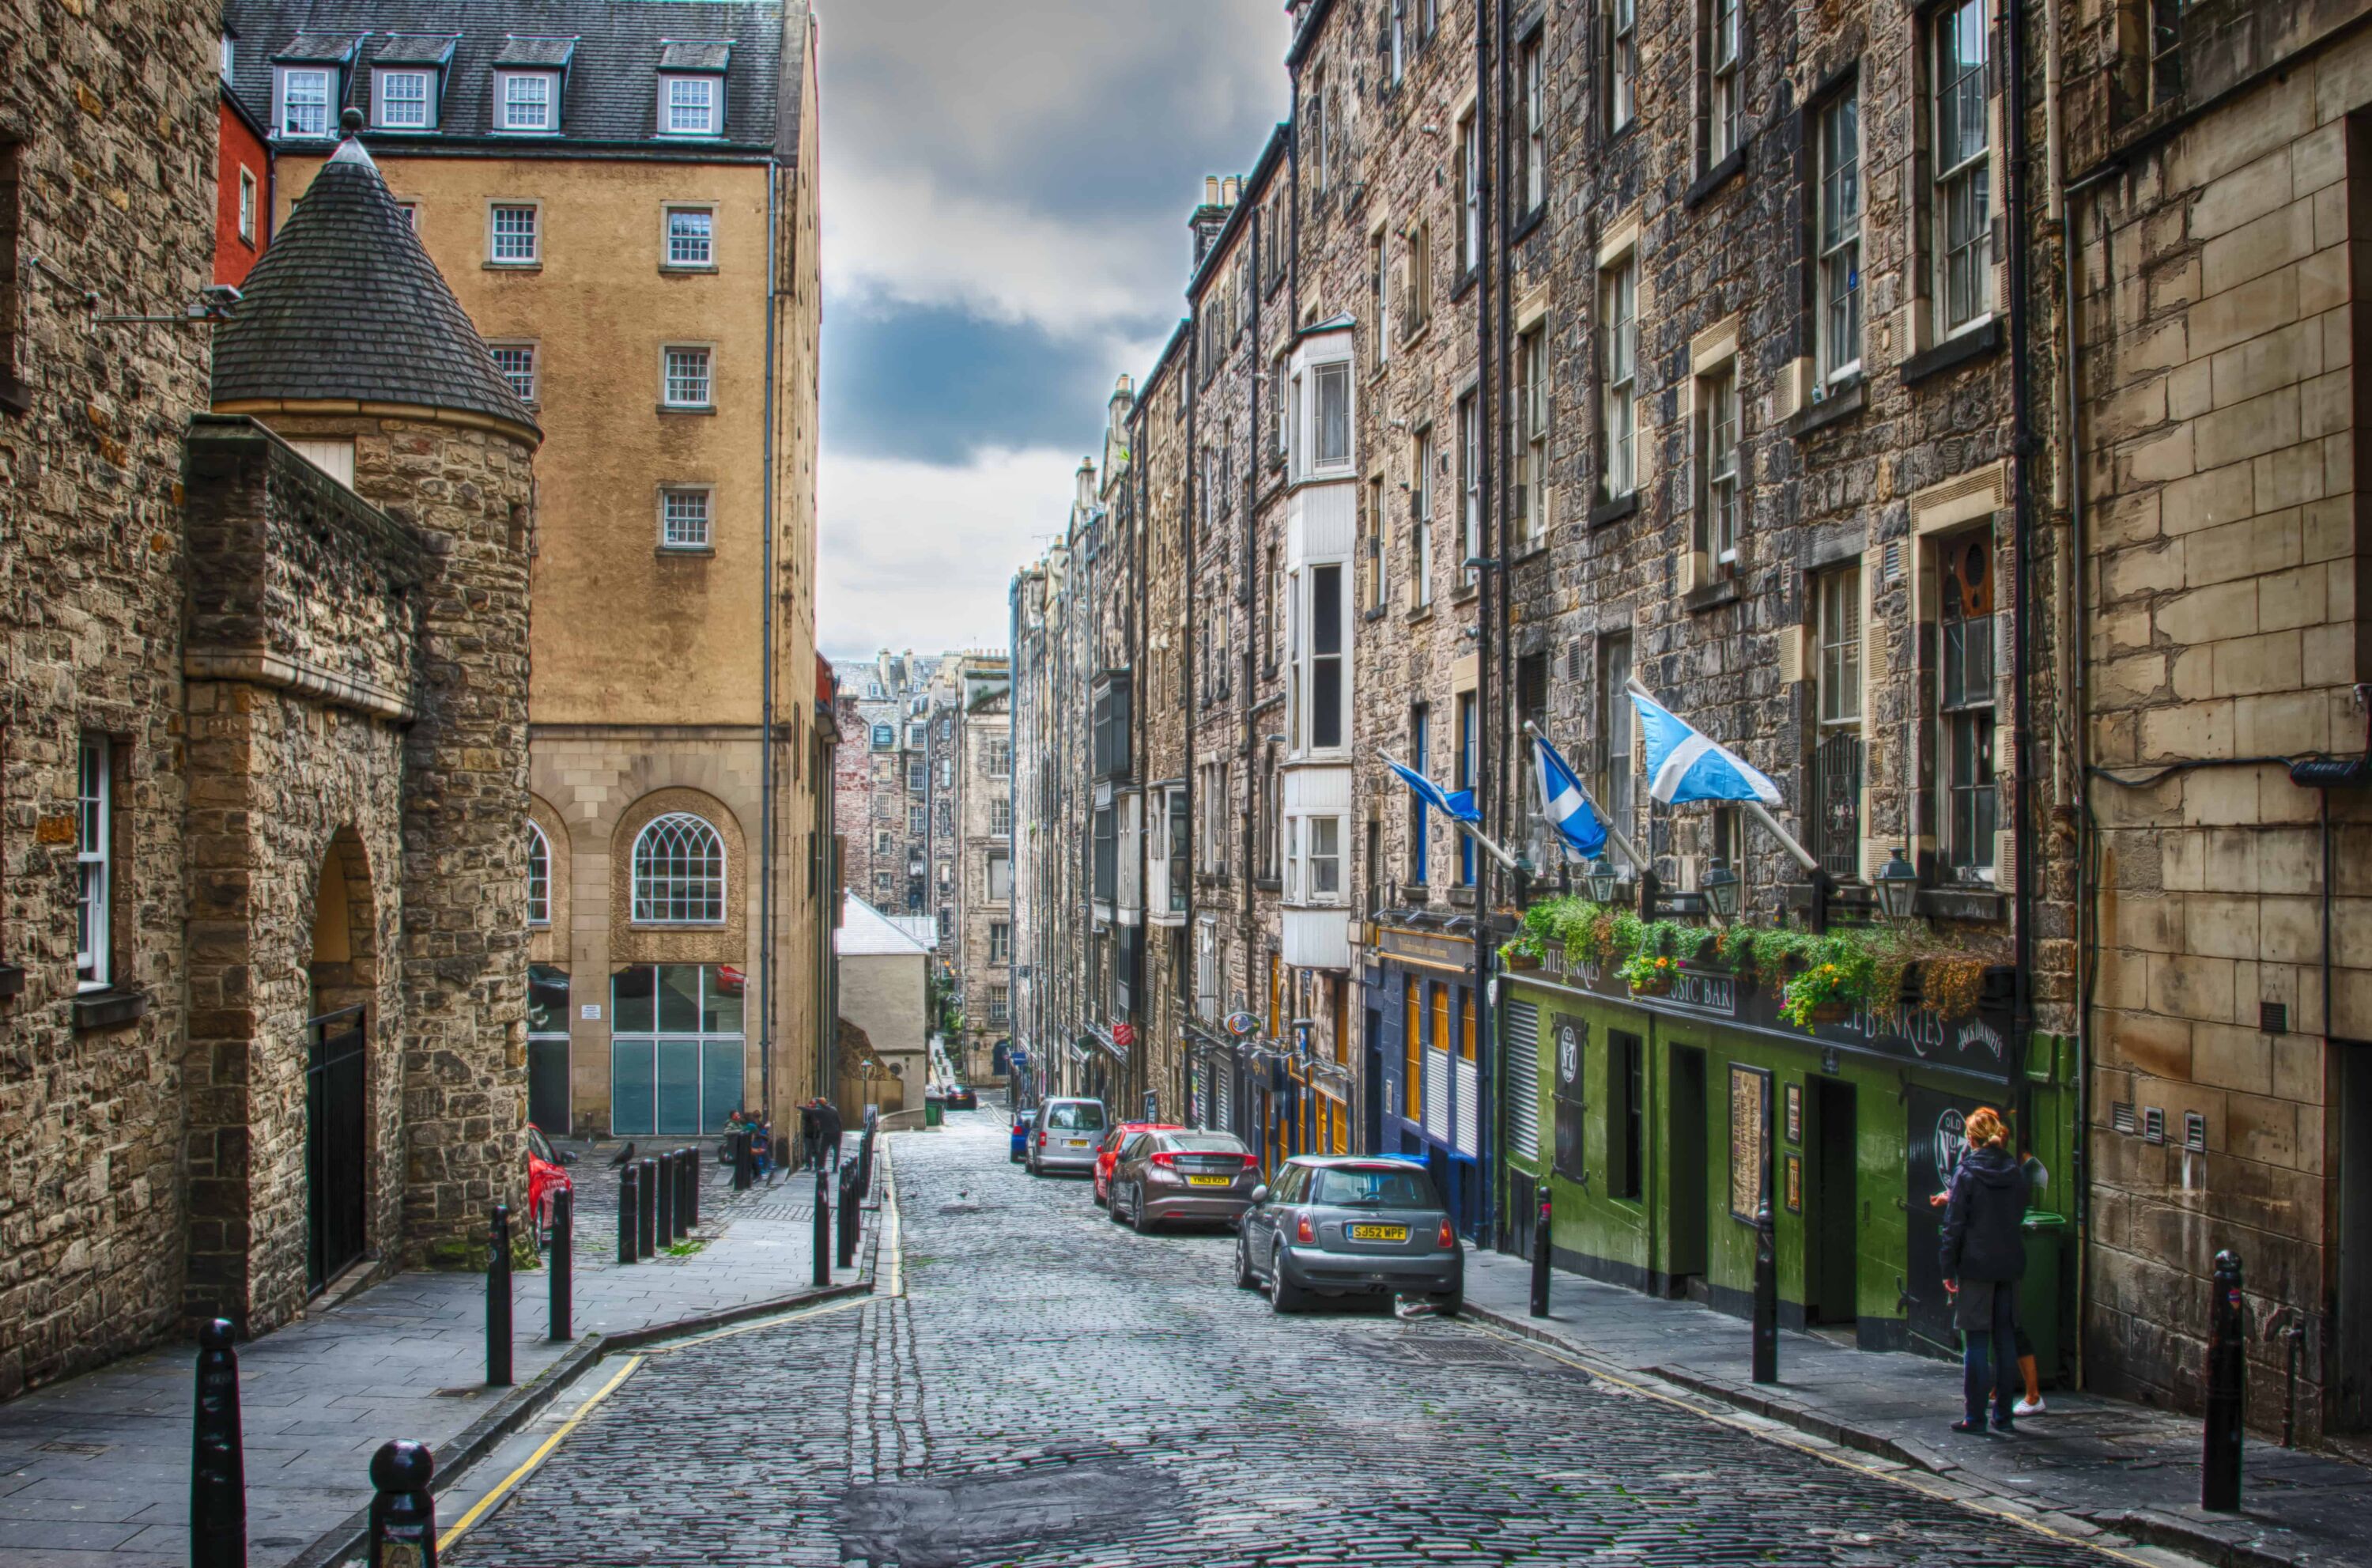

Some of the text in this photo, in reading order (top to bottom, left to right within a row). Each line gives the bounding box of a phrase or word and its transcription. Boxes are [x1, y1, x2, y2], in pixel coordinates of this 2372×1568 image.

[1670, 976, 1730, 1008] USIC BAR
[1945, 1116, 1962, 1131] OLD
[1354, 1226, 1404, 1238] SJ52 WPF
